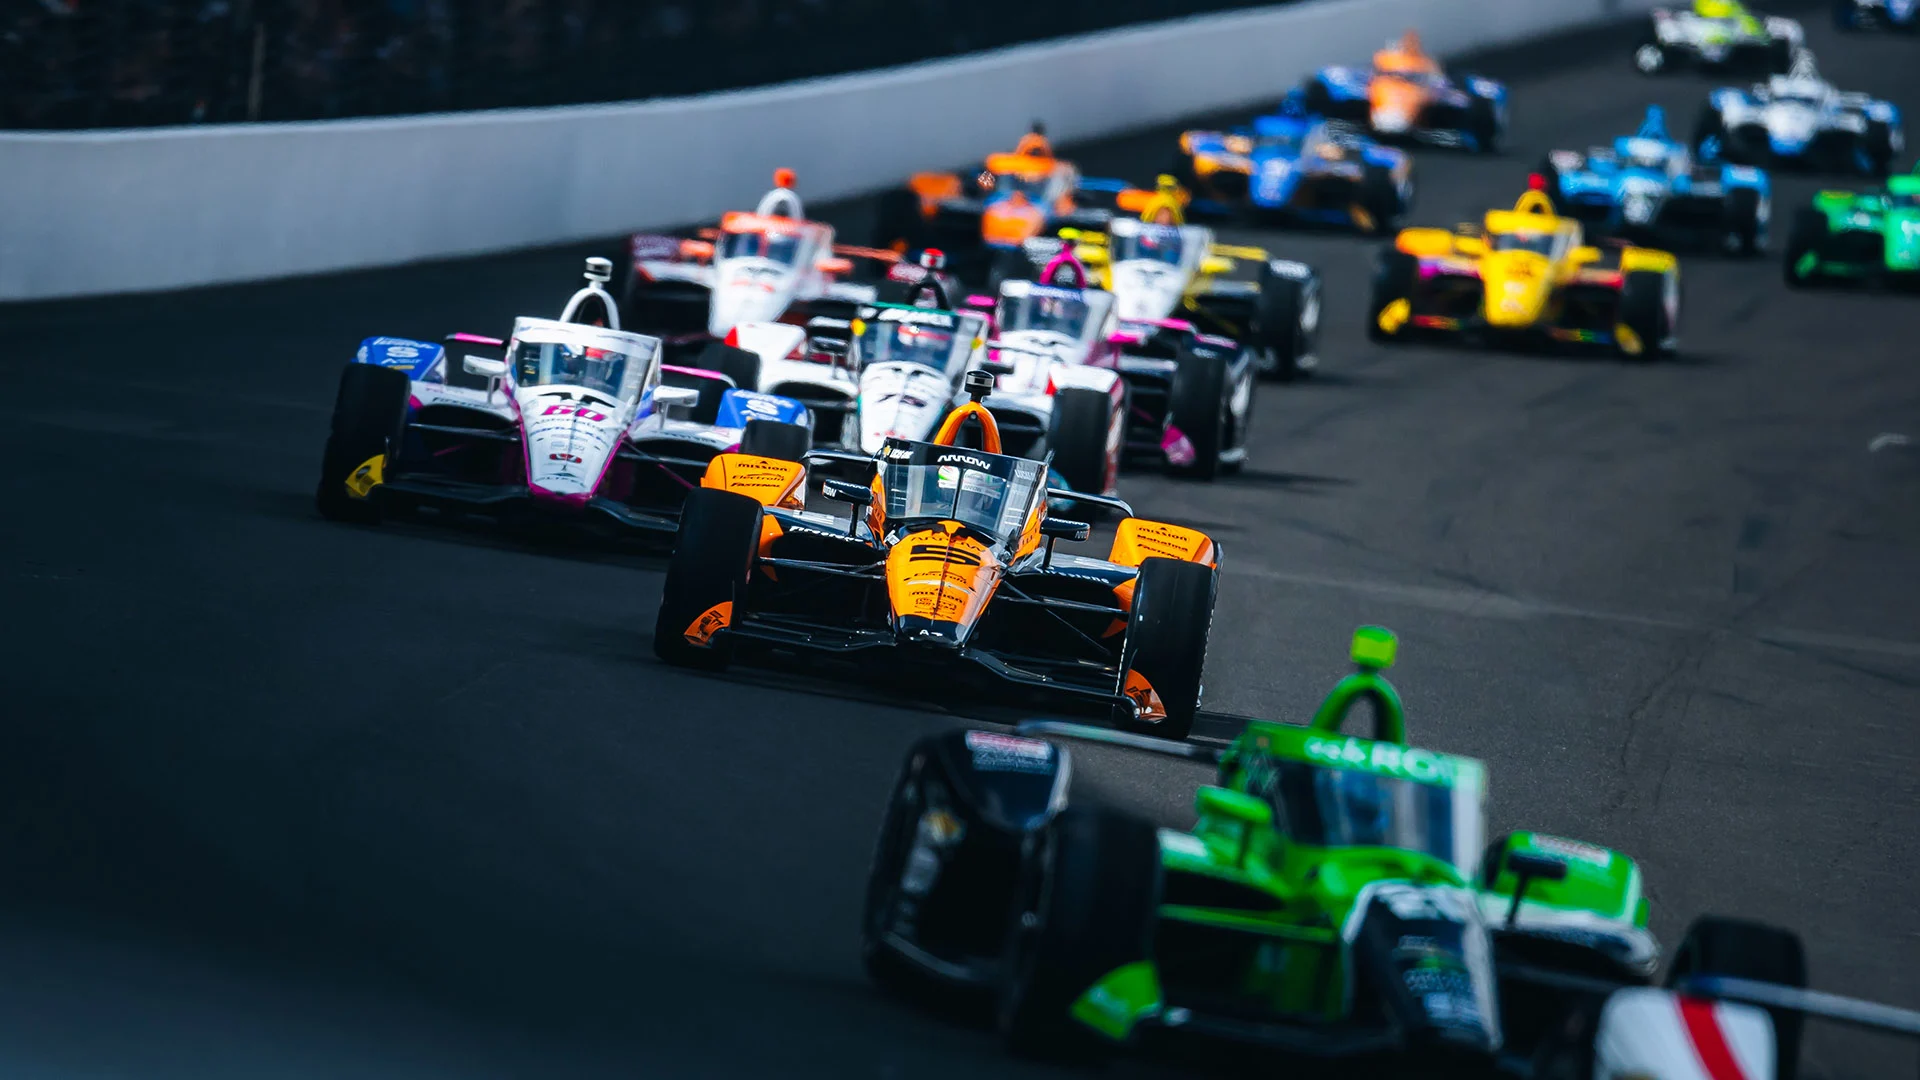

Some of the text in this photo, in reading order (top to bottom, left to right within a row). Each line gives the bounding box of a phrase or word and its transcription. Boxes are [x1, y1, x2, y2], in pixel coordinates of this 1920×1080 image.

[541, 405, 607, 422] 60
[738, 463, 788, 472] mission
[1139, 526, 1188, 542] mission
[1136, 533, 1189, 553] Mahatma
